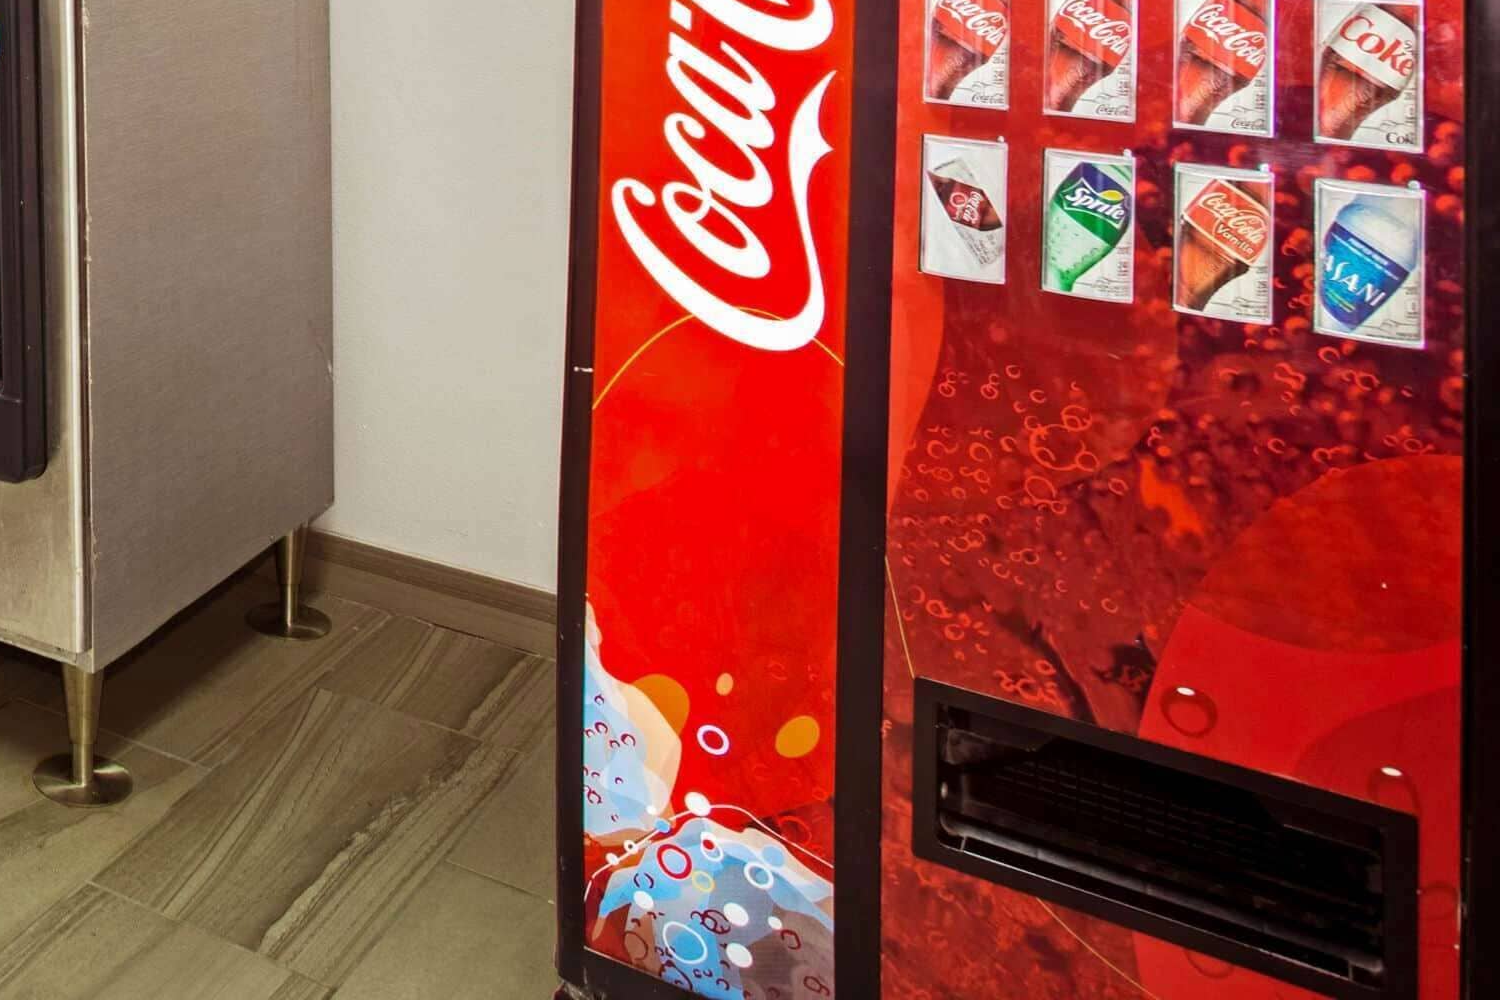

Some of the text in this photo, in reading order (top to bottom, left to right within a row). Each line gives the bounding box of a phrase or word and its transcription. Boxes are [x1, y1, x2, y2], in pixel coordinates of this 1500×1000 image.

[1339, 14, 1414, 77] Coke
[1065, 186, 1126, 221] Sprite
[1200, 191, 1268, 245] Coca-Cola
[1218, 223, 1255, 255] Vanilla
[1323, 252, 1386, 307] ASANI
